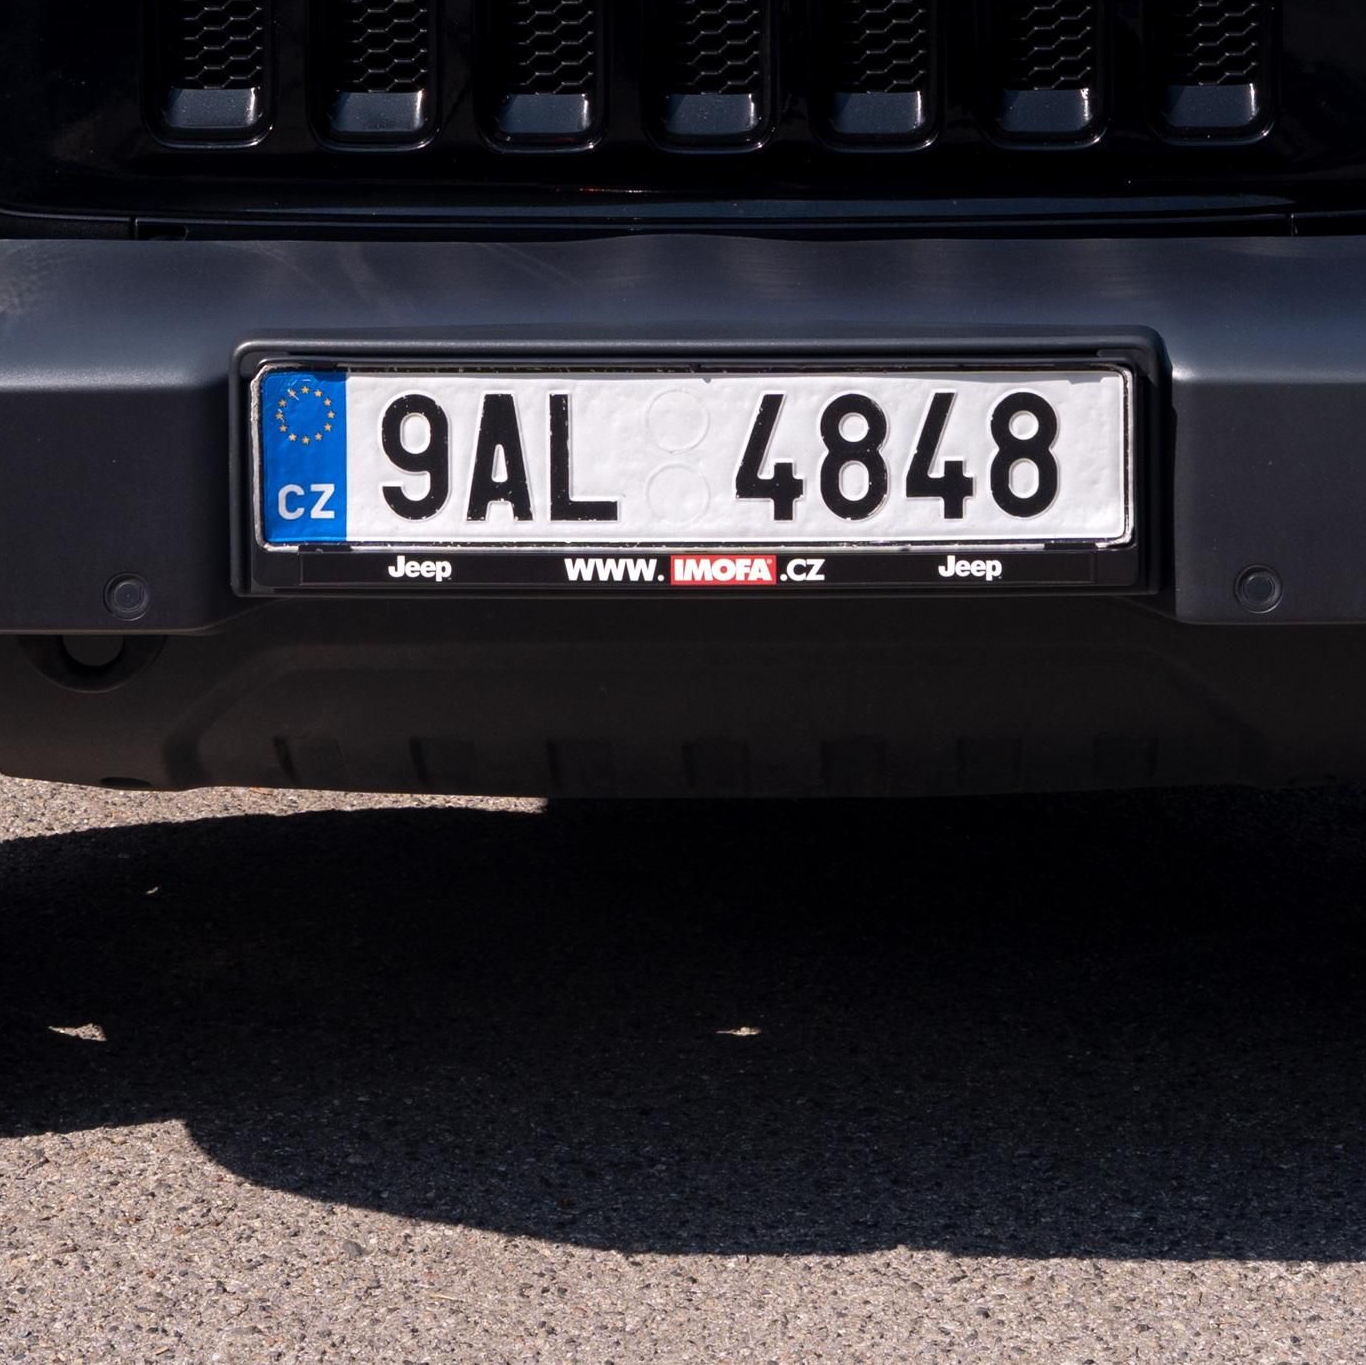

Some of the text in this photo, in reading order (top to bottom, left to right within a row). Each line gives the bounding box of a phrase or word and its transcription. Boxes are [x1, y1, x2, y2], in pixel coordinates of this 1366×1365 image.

[381, 391, 1059, 522] 9AL 4848
[277, 484, 335, 519] CZ
[388, 555, 452, 582] Jeep
[938, 555, 1002, 581] Jeep
